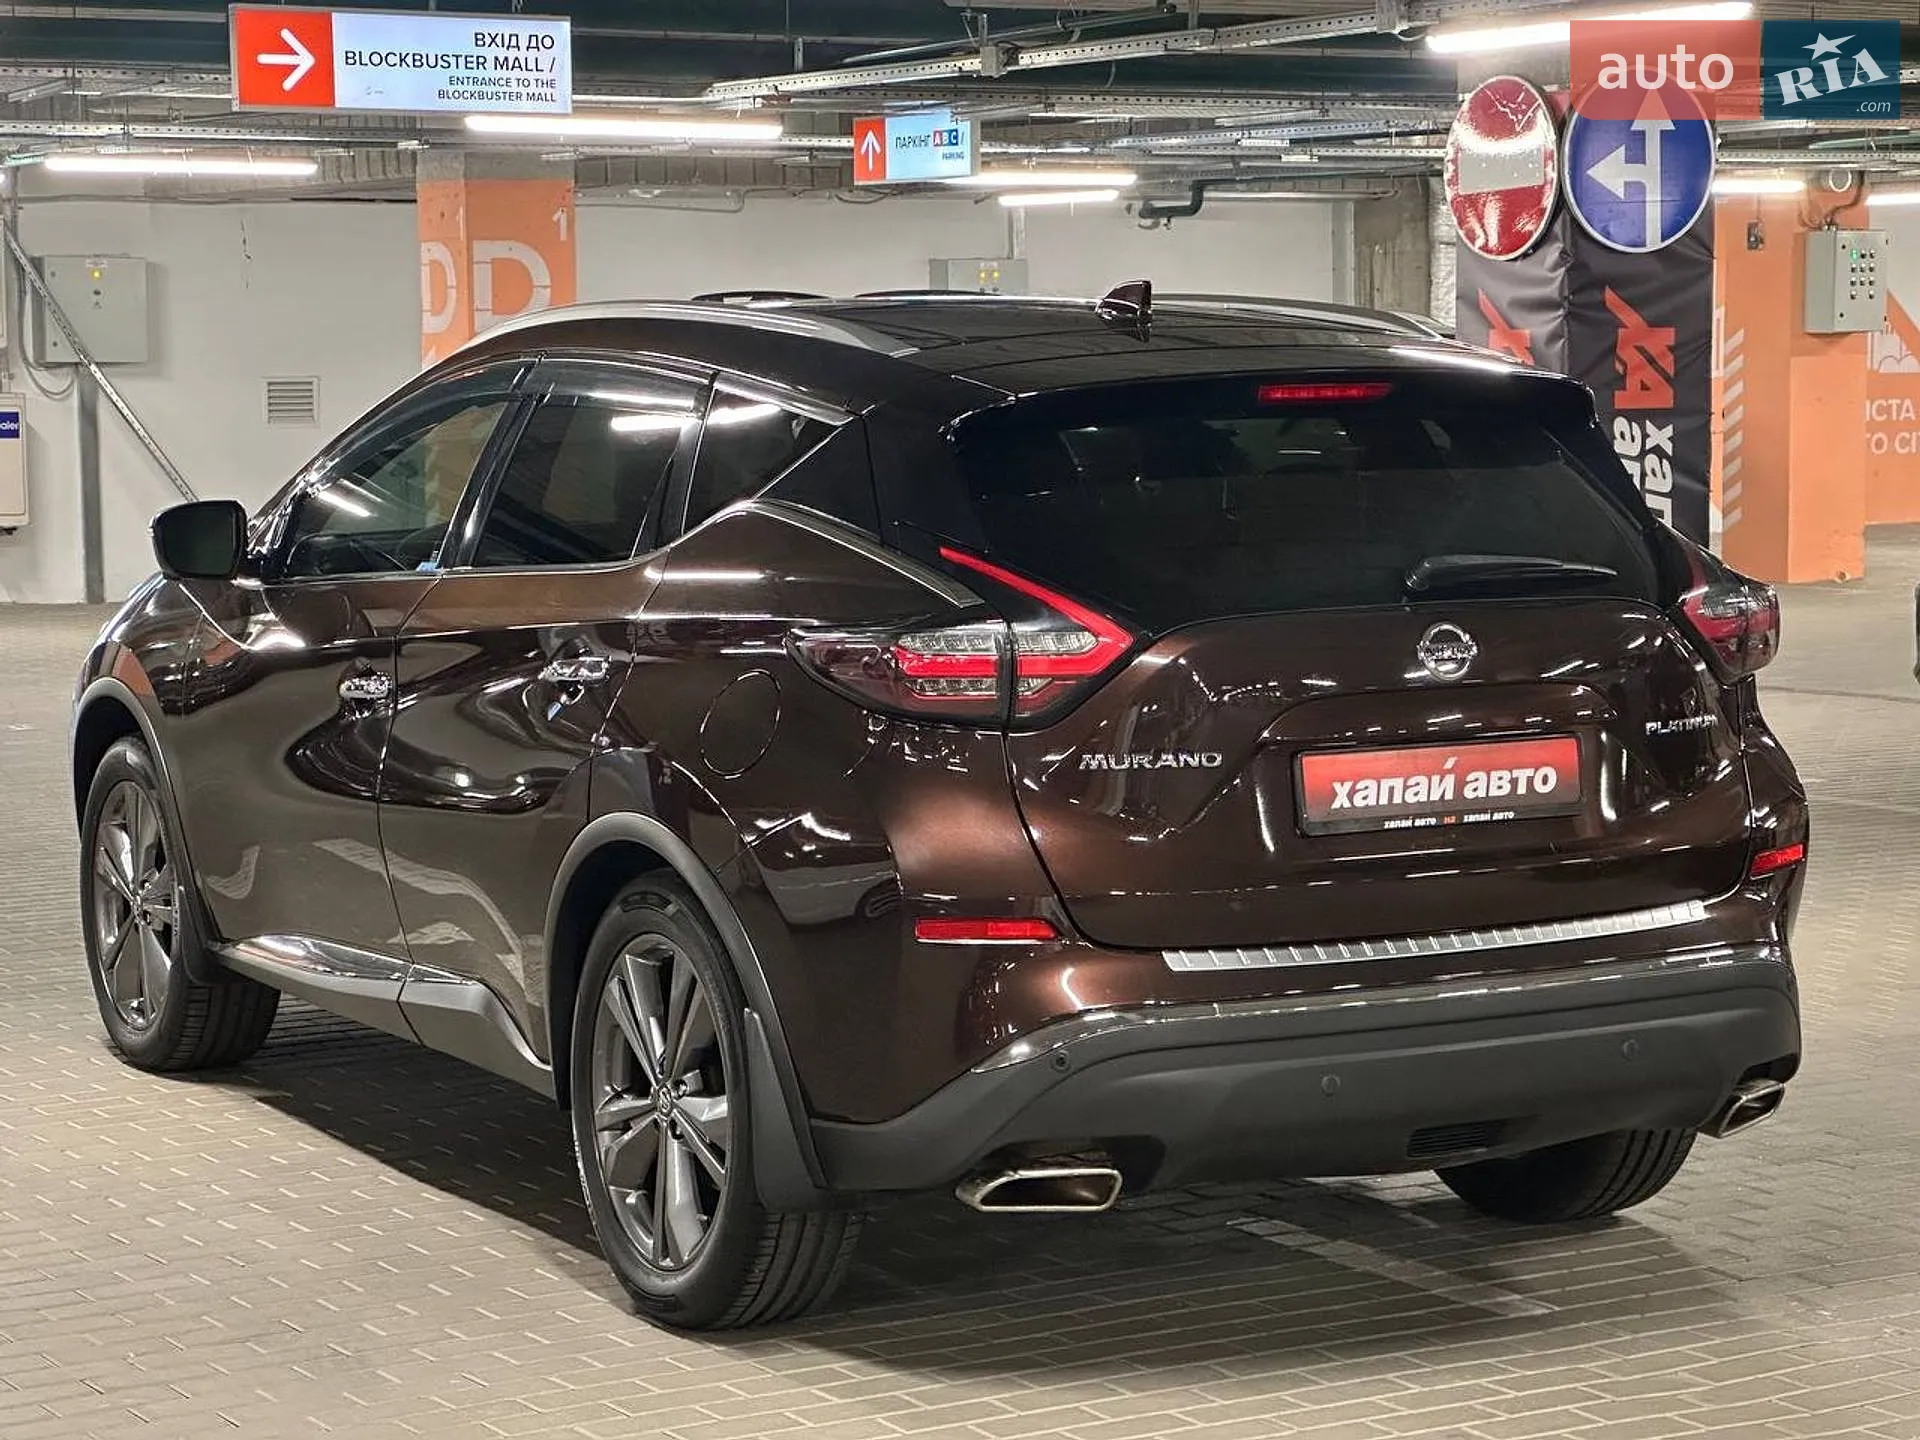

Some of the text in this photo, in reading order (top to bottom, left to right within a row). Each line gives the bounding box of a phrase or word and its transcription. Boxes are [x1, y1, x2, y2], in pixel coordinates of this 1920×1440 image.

[474, 32, 555, 52] ВХІД ДО
[344, 50, 487, 71] BLOCKBUSTER
[493, 56, 544, 72] MALL
[448, 76, 557, 90] ENTRANCE TO THE
[437, 88, 557, 103] BLOCKBUSTER MALL
[552, 207, 568, 241] 1
[473, 239, 552, 334] D
[1865, 398, 1916, 421] ІСТА
[1895, 431, 1920, 454] CI
[1079, 752, 1223, 770] MURANO
[1463, 766, 1558, 800] авто
